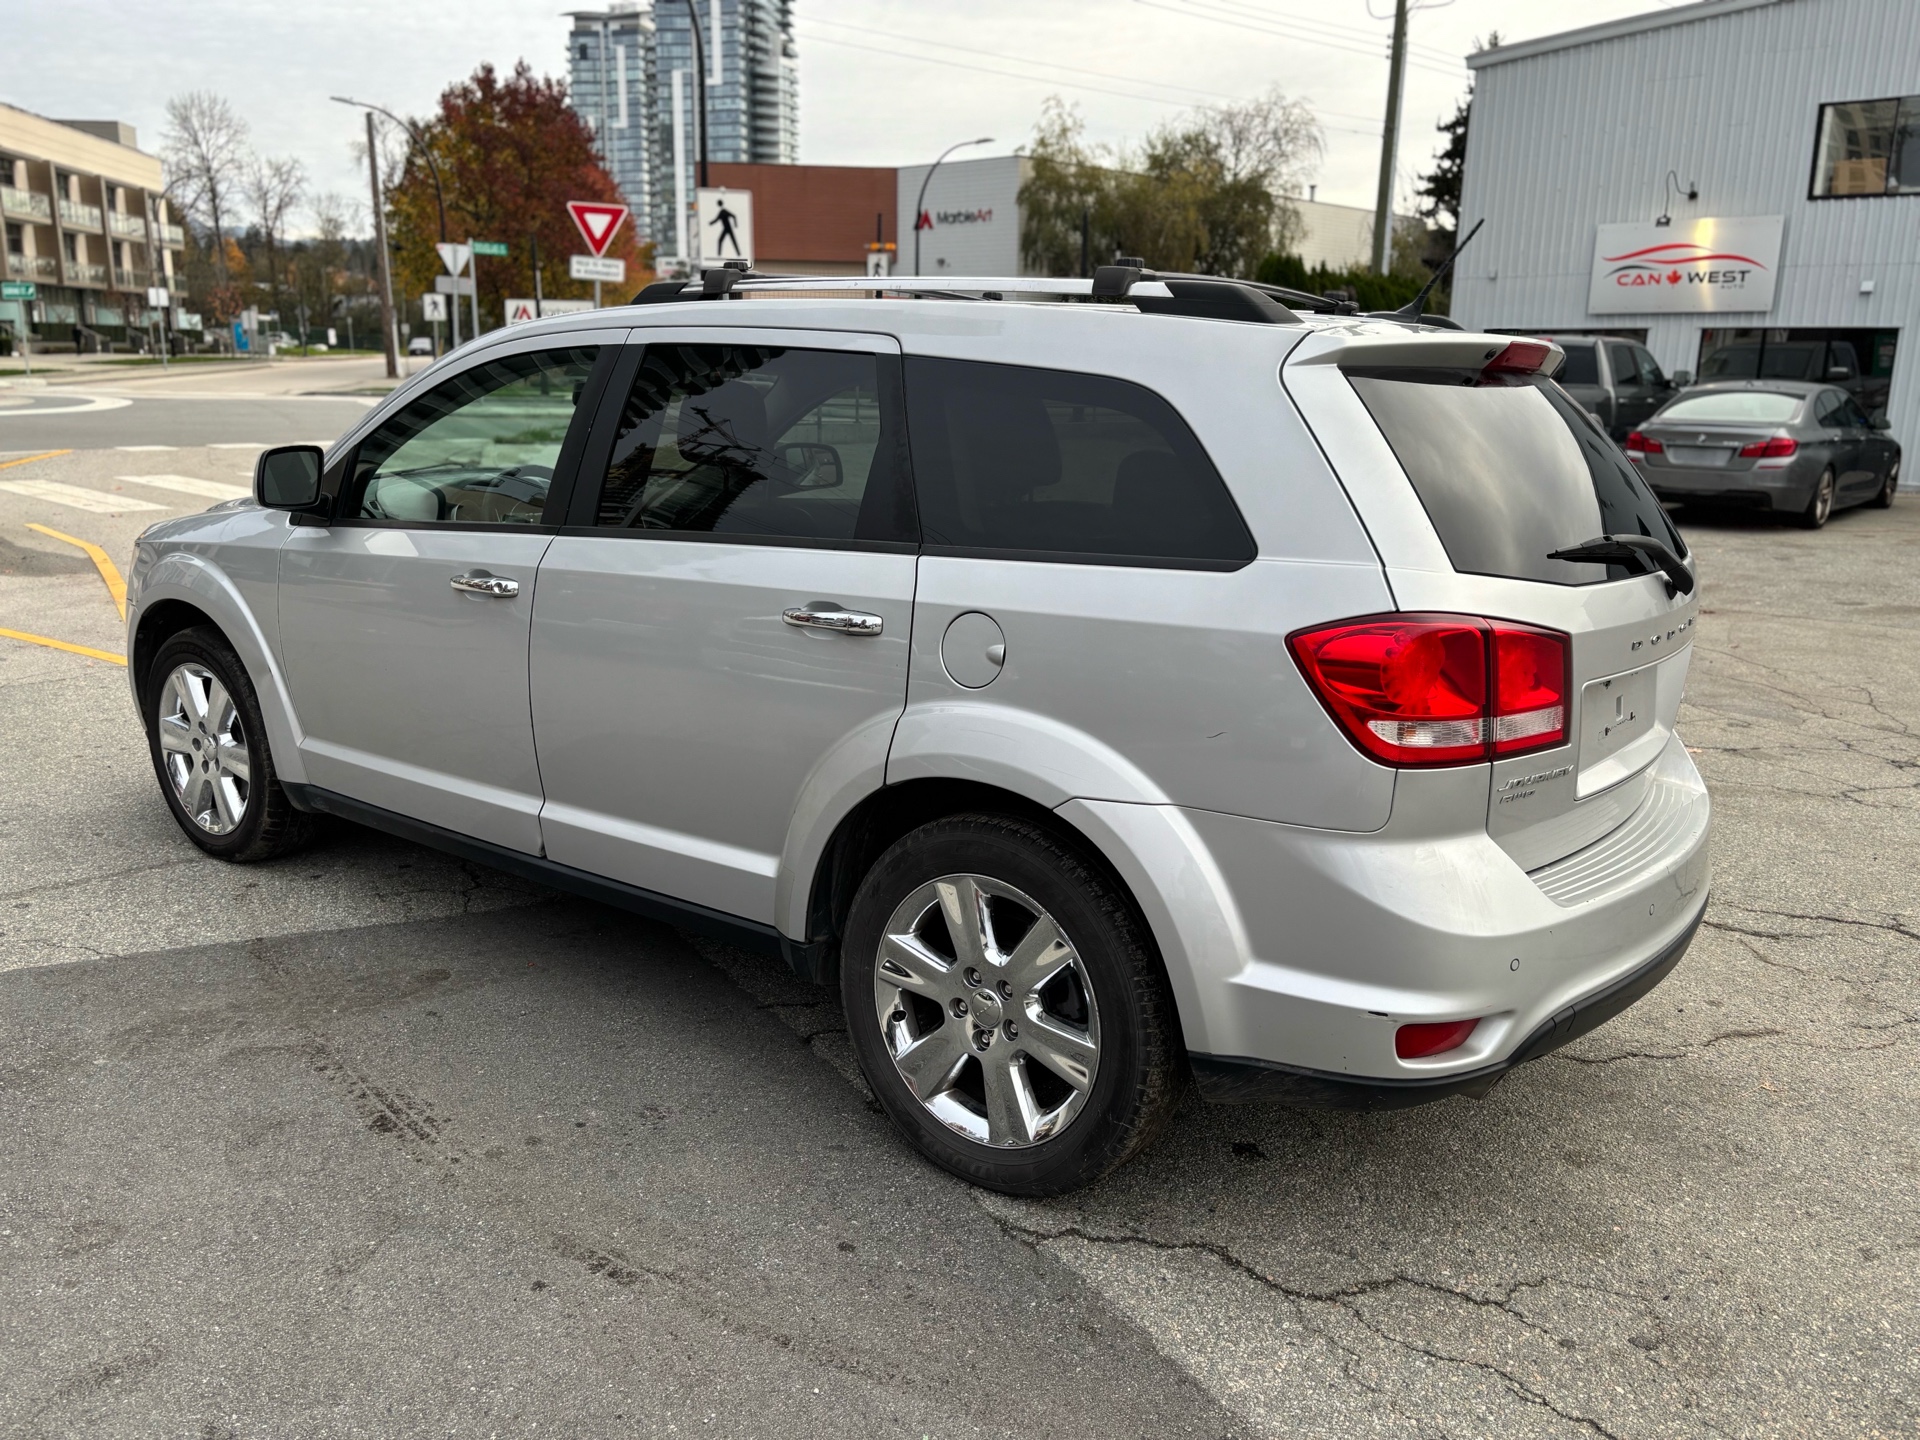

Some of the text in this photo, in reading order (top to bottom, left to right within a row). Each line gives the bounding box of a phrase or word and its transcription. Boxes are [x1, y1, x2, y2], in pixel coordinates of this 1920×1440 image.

[1616, 270, 1752, 286] CAN WEST
[1497, 764, 1574, 791] JOURNEY
